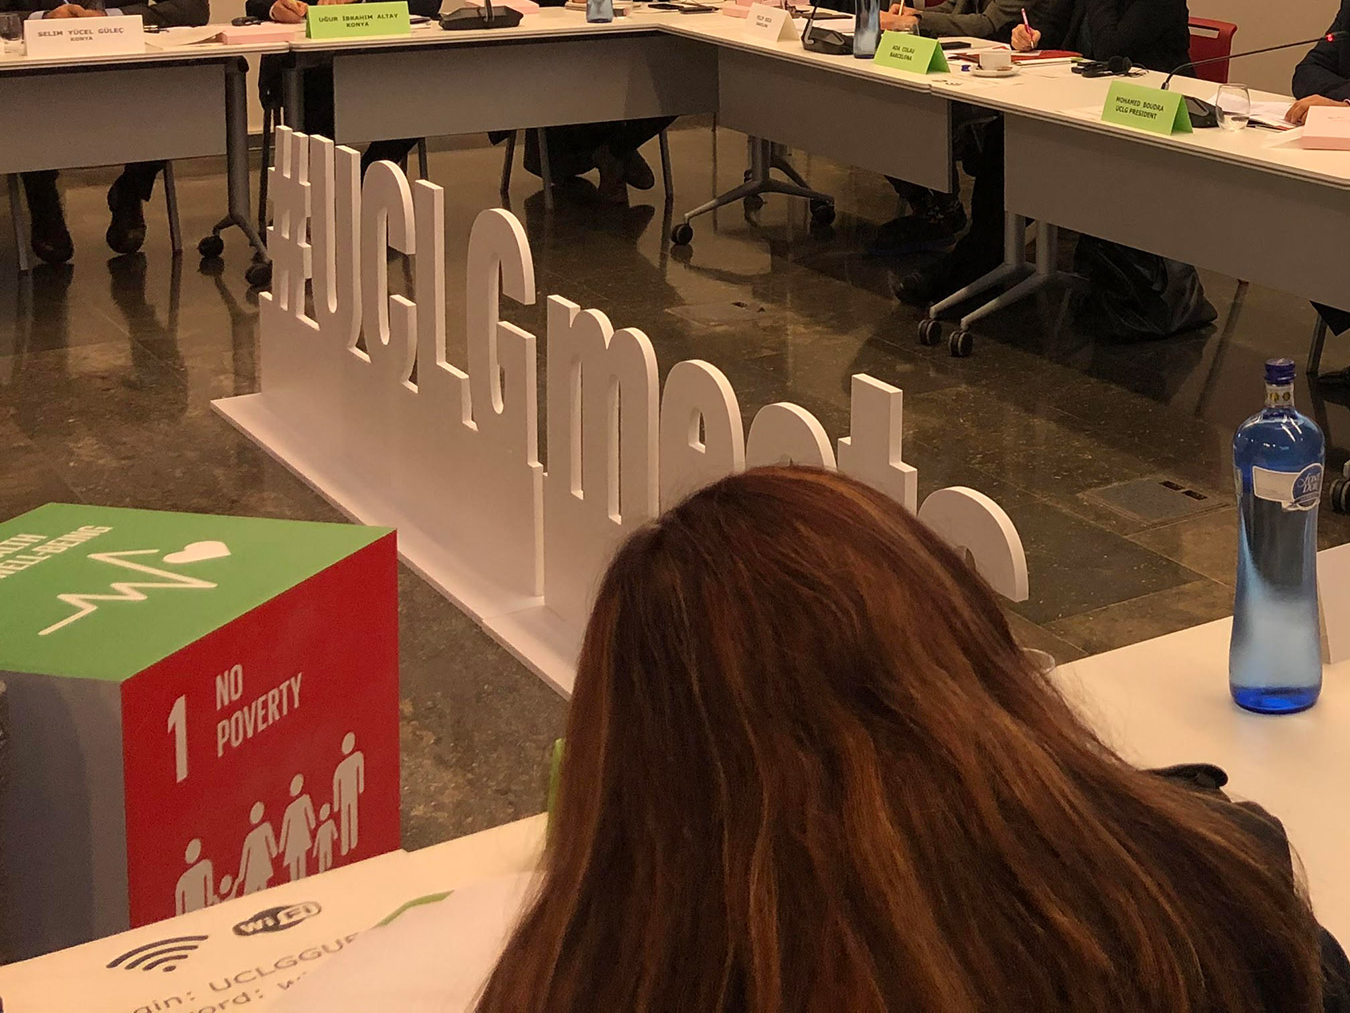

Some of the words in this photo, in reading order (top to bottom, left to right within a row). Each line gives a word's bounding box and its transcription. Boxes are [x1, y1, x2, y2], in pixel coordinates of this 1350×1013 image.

[1115, 105, 1128, 113] UCLG
[1129, 108, 1158, 120] PRESIDENT
[1116, 96, 1140, 107] MOHAMED
[1143, 101, 1164, 112] BOUDRA
[167, 693, 187, 783] 1
[215, 663, 243, 710] NO
[216, 672, 303, 758] POVERTY
